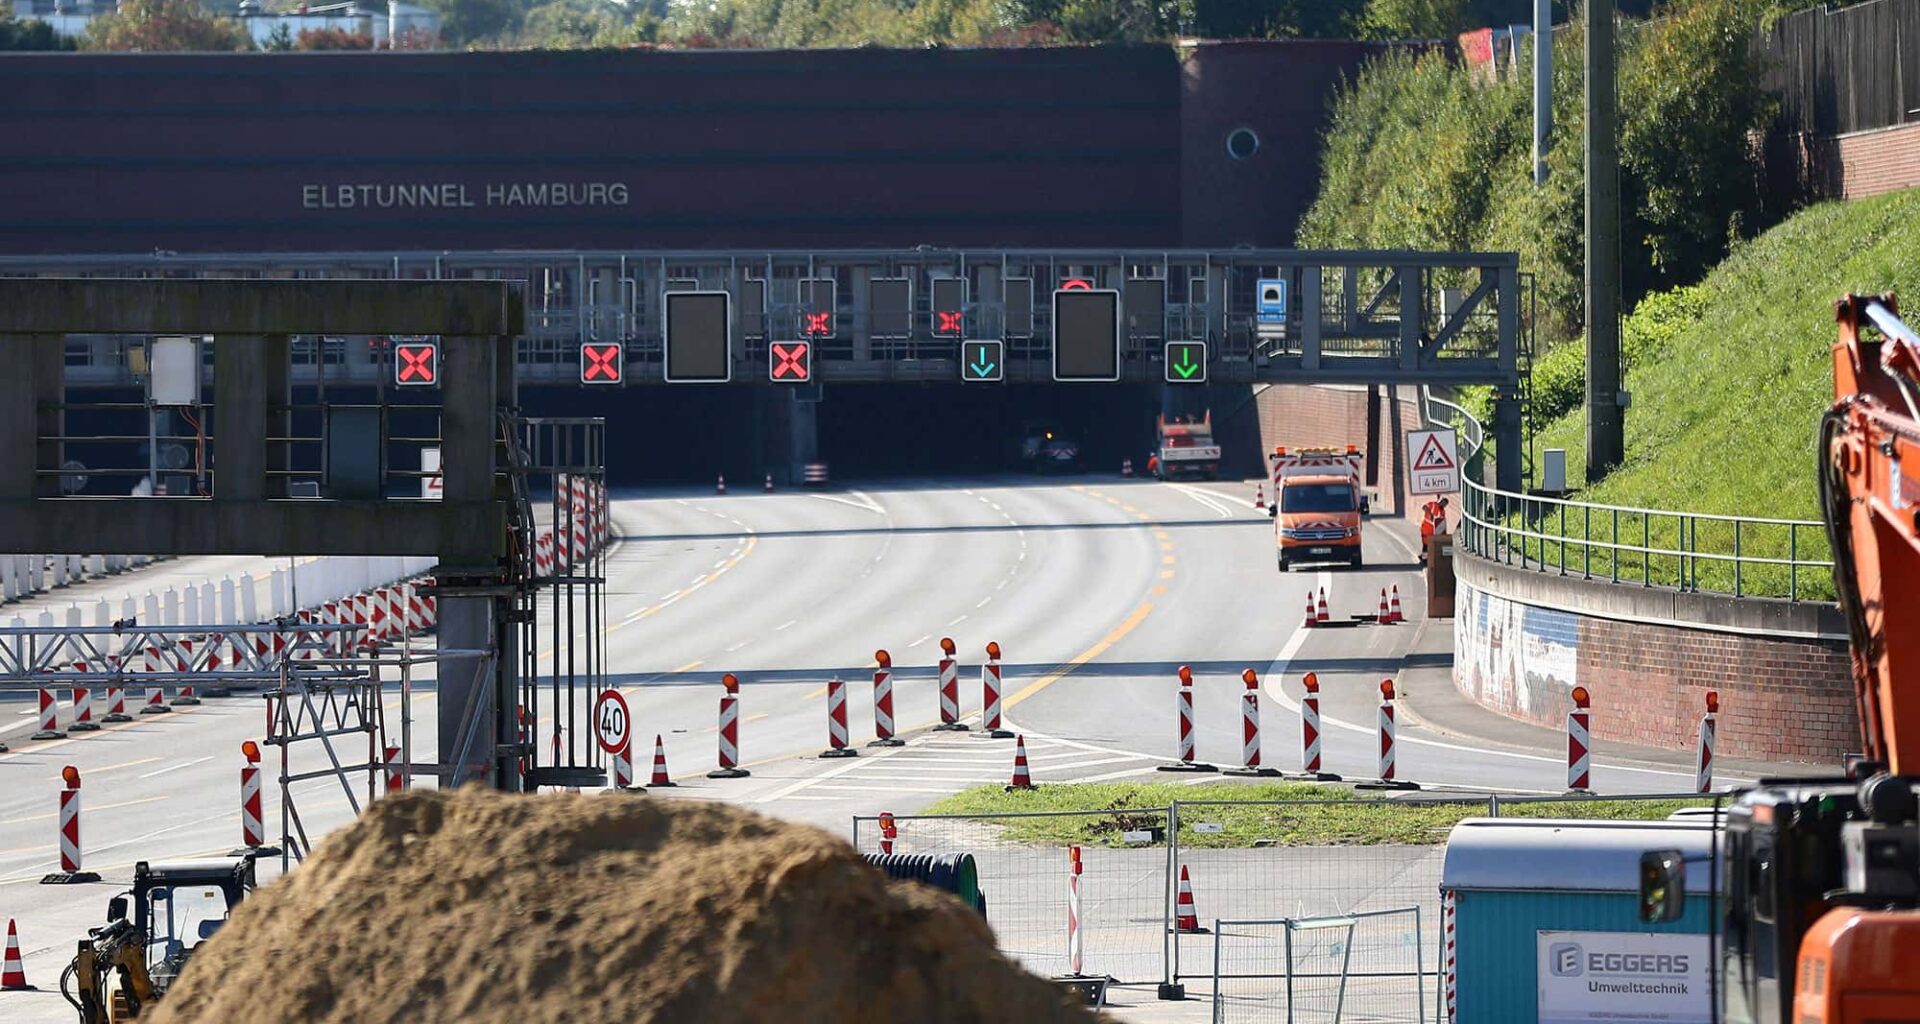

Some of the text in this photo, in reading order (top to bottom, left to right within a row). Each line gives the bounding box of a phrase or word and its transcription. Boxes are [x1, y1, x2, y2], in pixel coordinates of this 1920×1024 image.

[302, 182, 629, 208] ELBTUNNEL HAMBURG
[1424, 478, 1447, 487] 4 km
[601, 706, 623, 736] 40
[1588, 952, 1689, 974] EGGERS
[1588, 980, 1689, 995] Umwelttechnik
